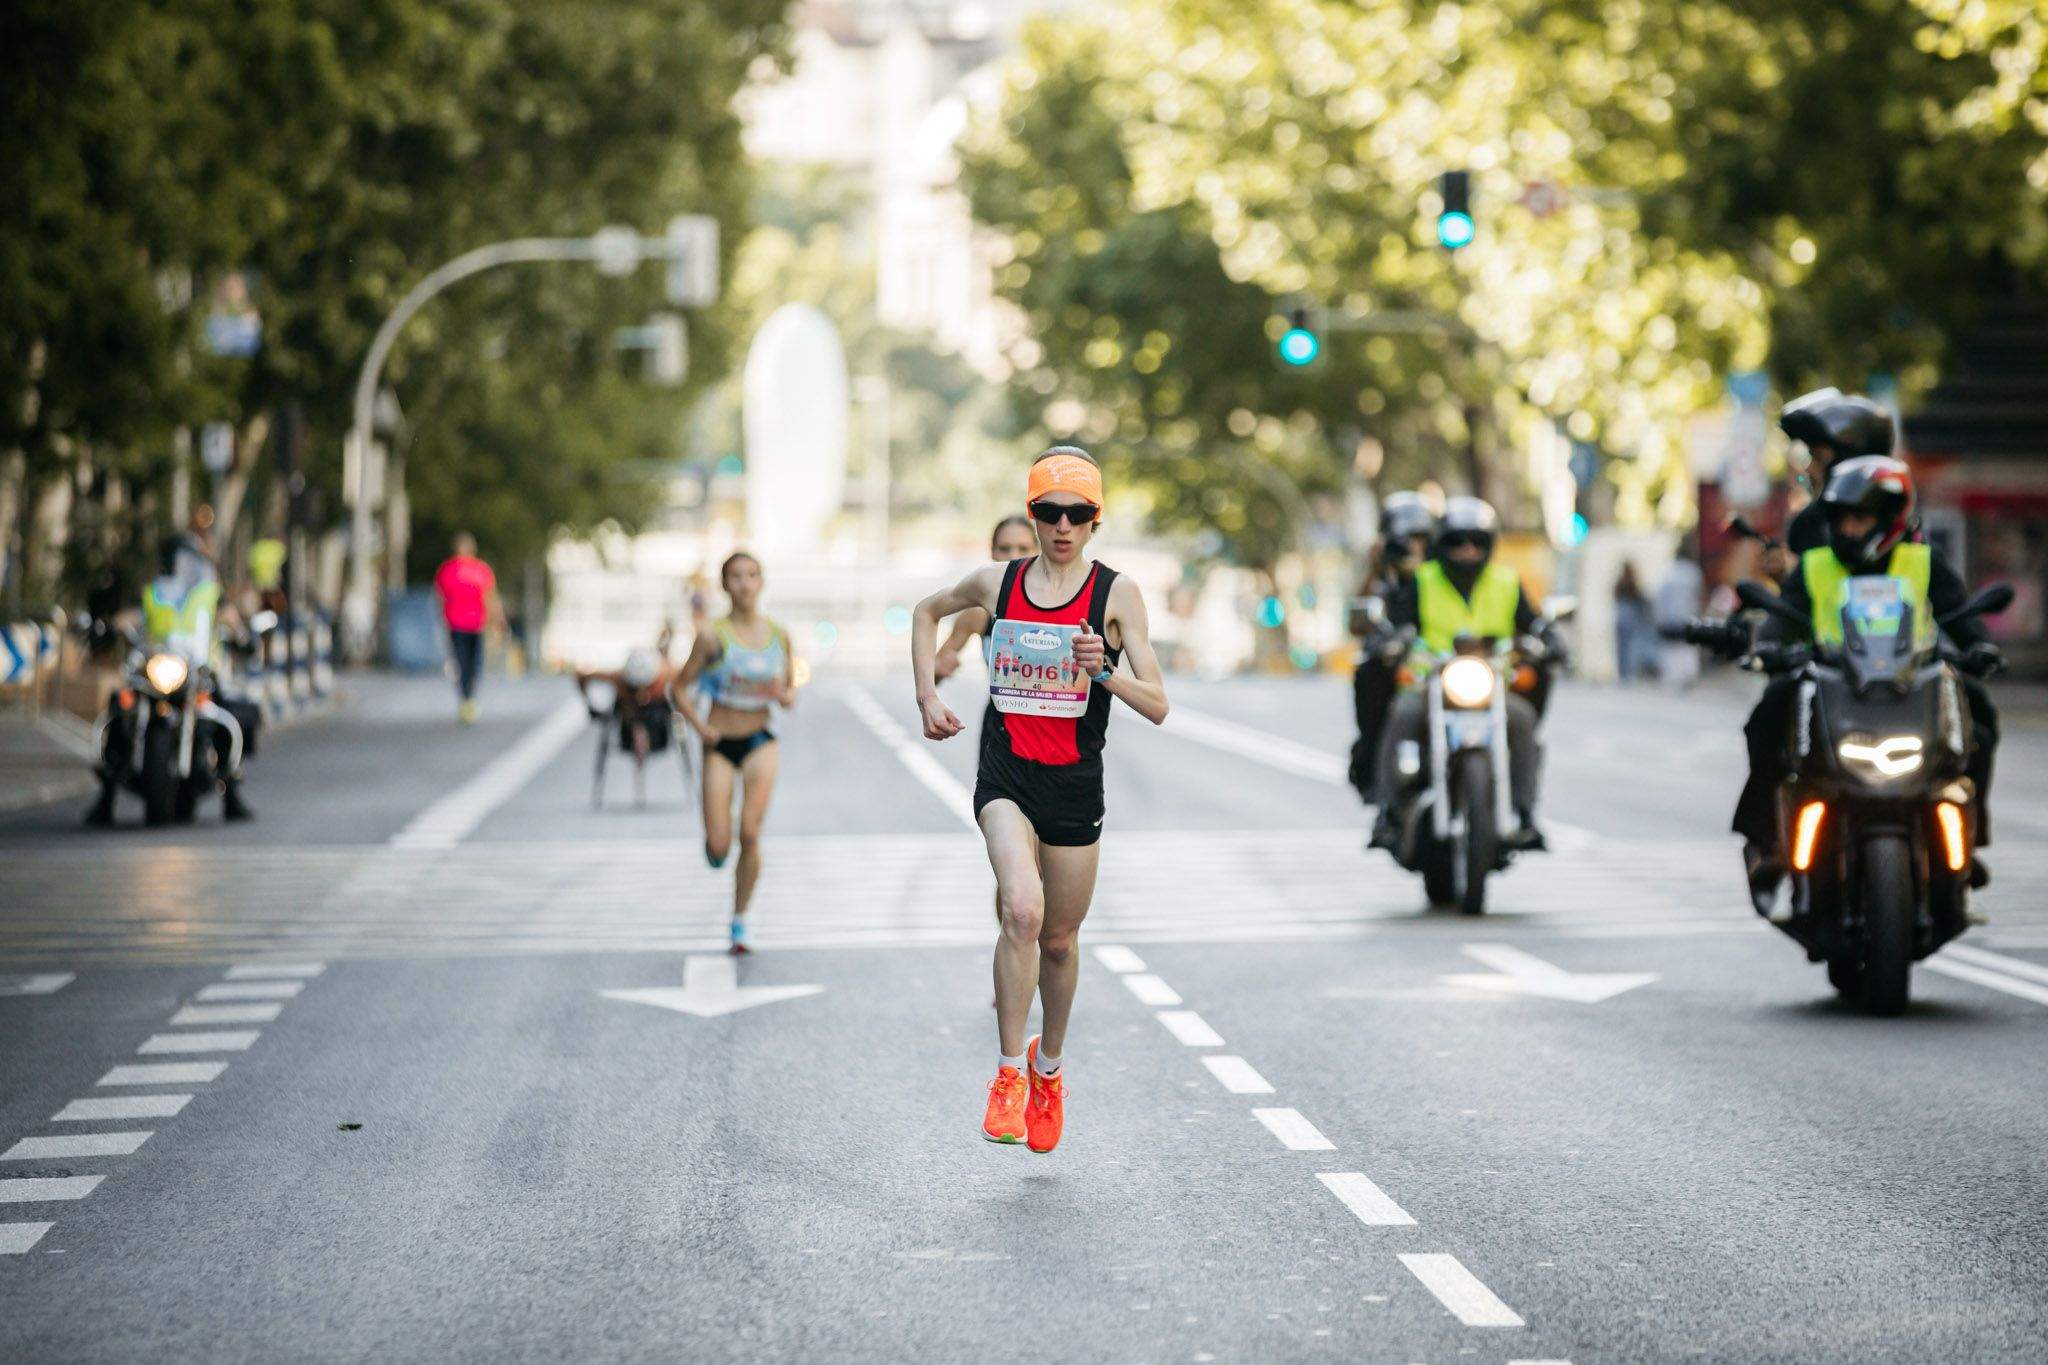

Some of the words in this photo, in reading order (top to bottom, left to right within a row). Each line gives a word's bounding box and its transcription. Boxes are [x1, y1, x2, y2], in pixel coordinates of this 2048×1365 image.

[1024, 635, 1059, 646] ASTURIANA
[1021, 663, 1058, 680] 016
[997, 698, 1028, 709] OYSHO
[1047, 704, 1077, 712] Santander
